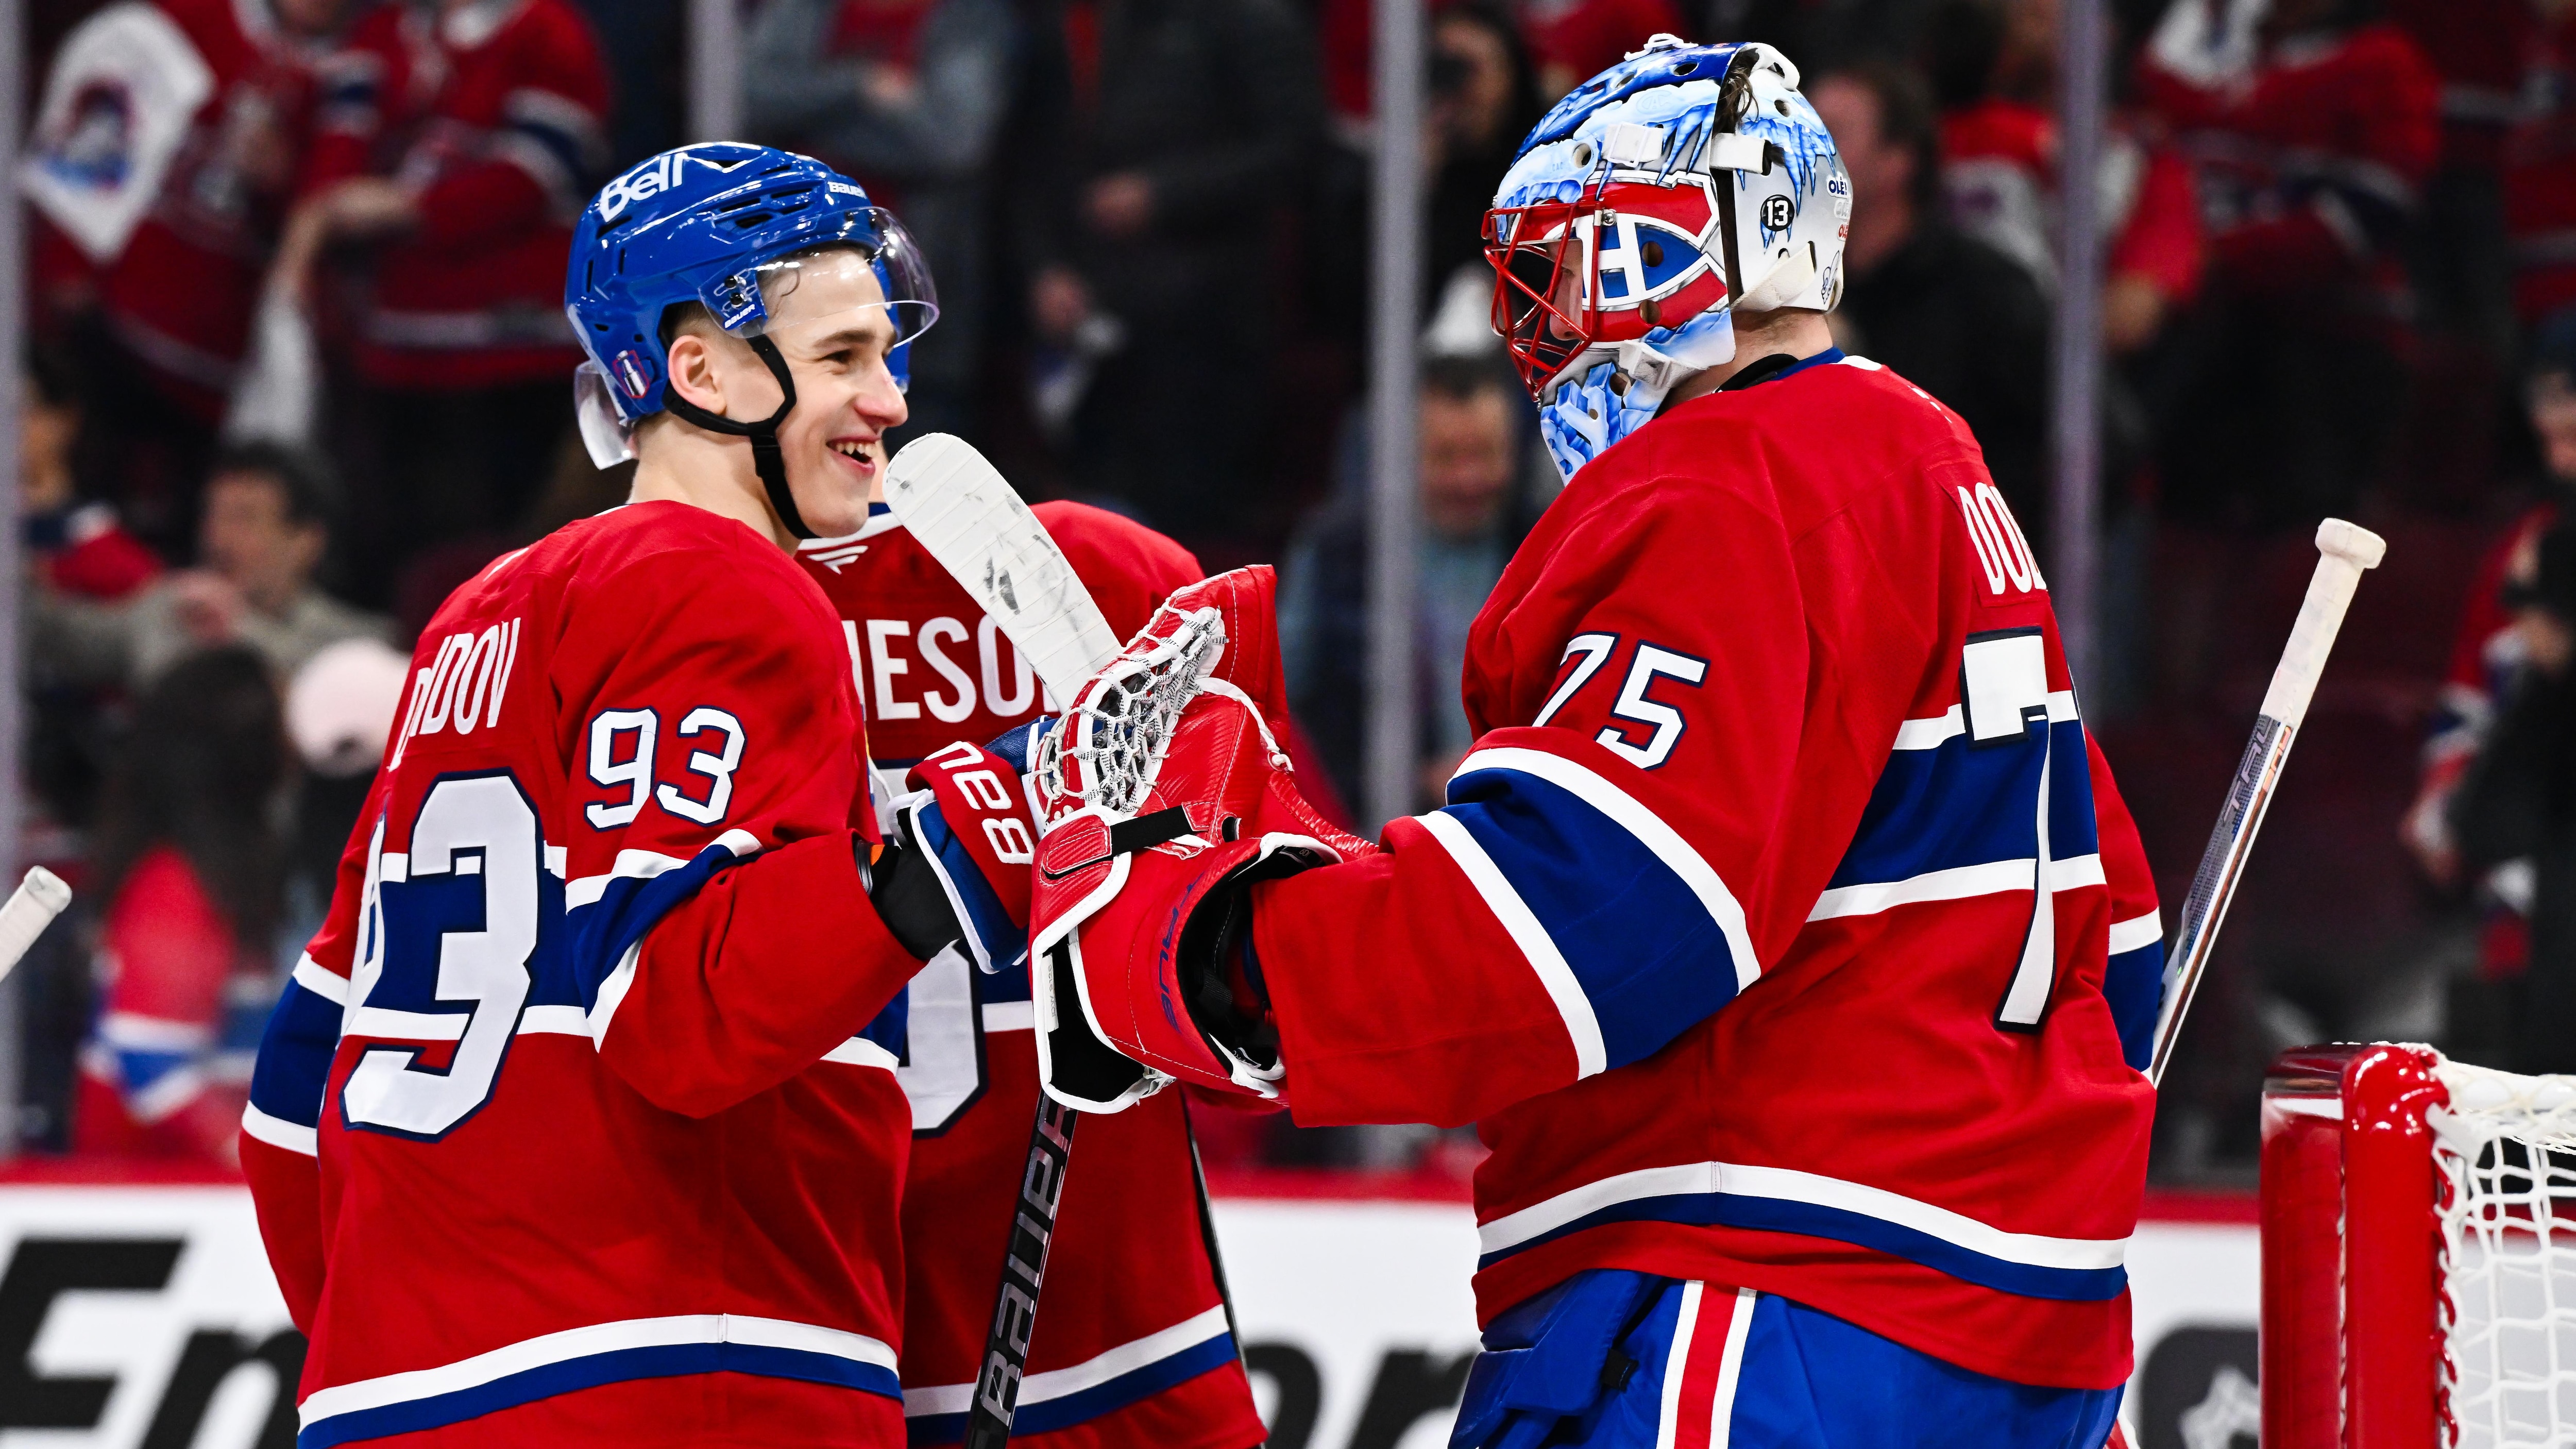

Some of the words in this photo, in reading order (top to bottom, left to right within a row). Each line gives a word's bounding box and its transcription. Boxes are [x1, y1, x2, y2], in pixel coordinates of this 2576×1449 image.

[599, 153, 687, 223] Bell
[1767, 200, 1789, 227] 13
[724, 304, 755, 328] BAUER
[842, 615, 1059, 723] ESO
[1531, 631, 1710, 771] 75
[584, 704, 748, 833] 93
